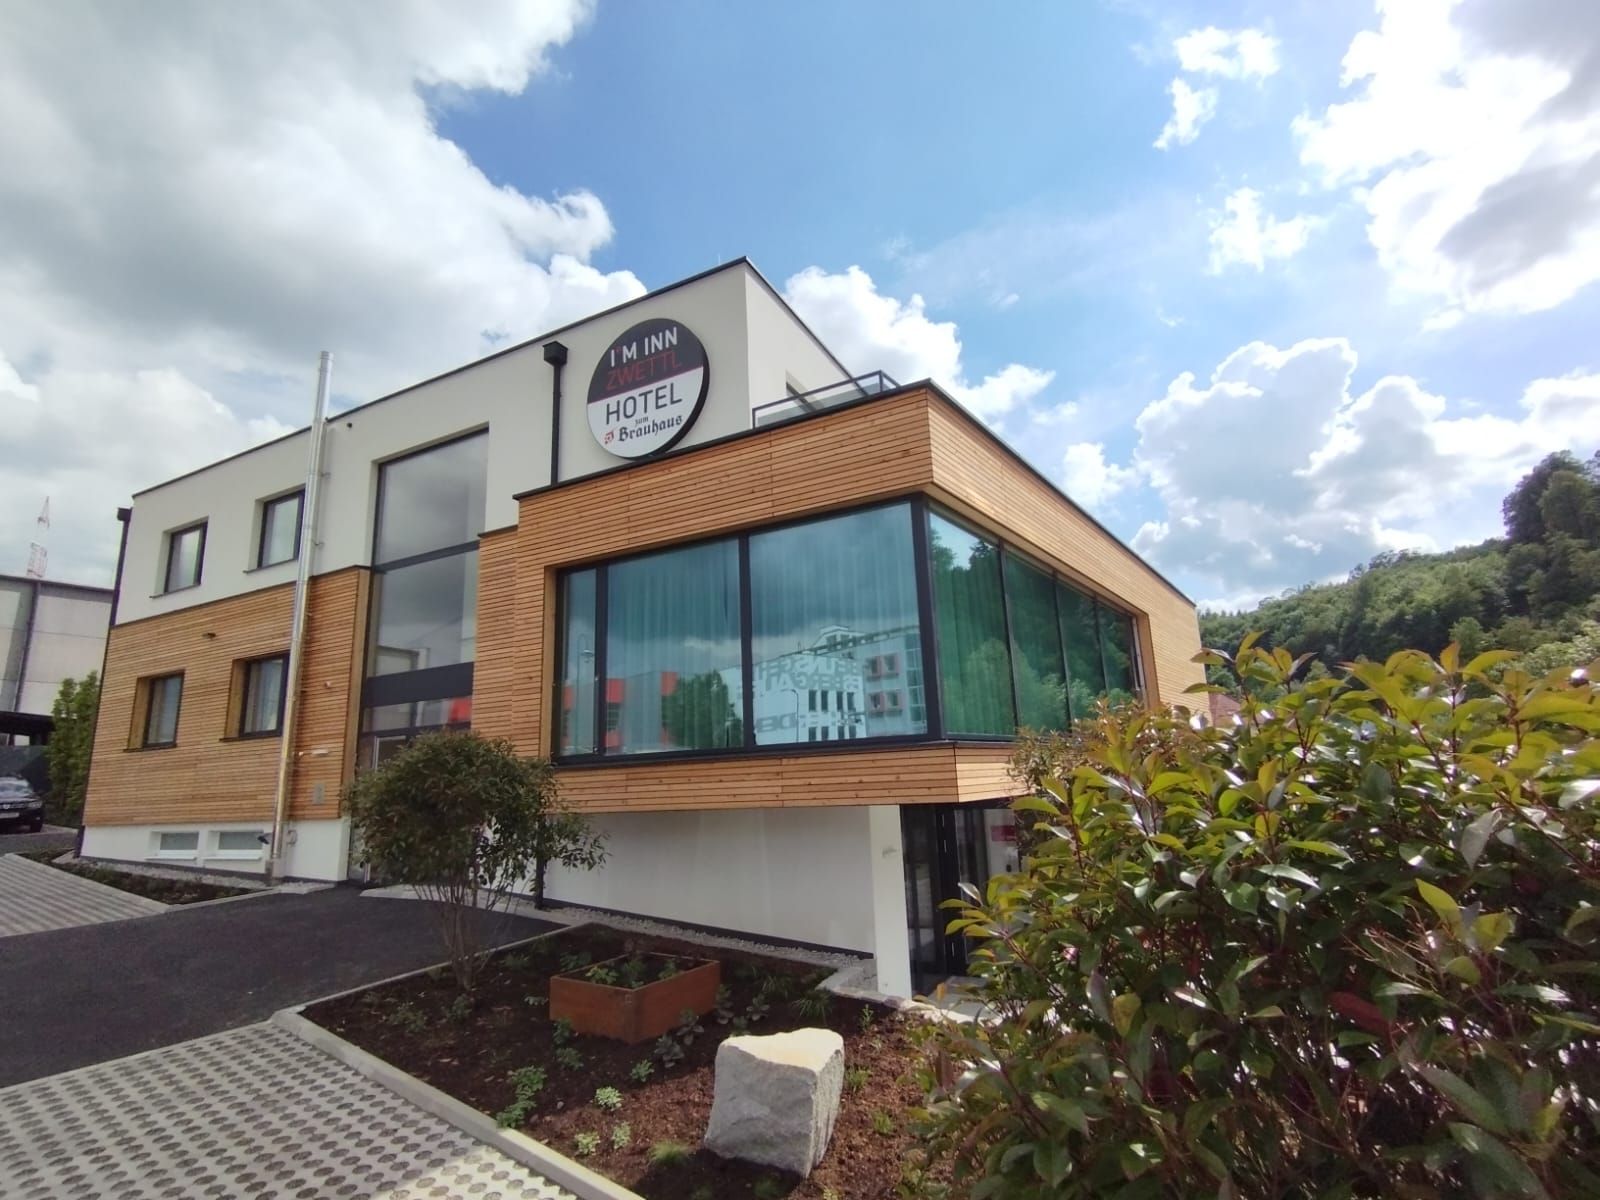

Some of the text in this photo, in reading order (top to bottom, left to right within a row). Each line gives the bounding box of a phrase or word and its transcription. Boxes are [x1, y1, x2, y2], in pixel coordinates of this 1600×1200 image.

[645, 326, 678, 355] INN
[606, 351, 682, 391] ZWETTL
[606, 382, 683, 425] HOTEL
[618, 415, 683, 442] Brauhaus
